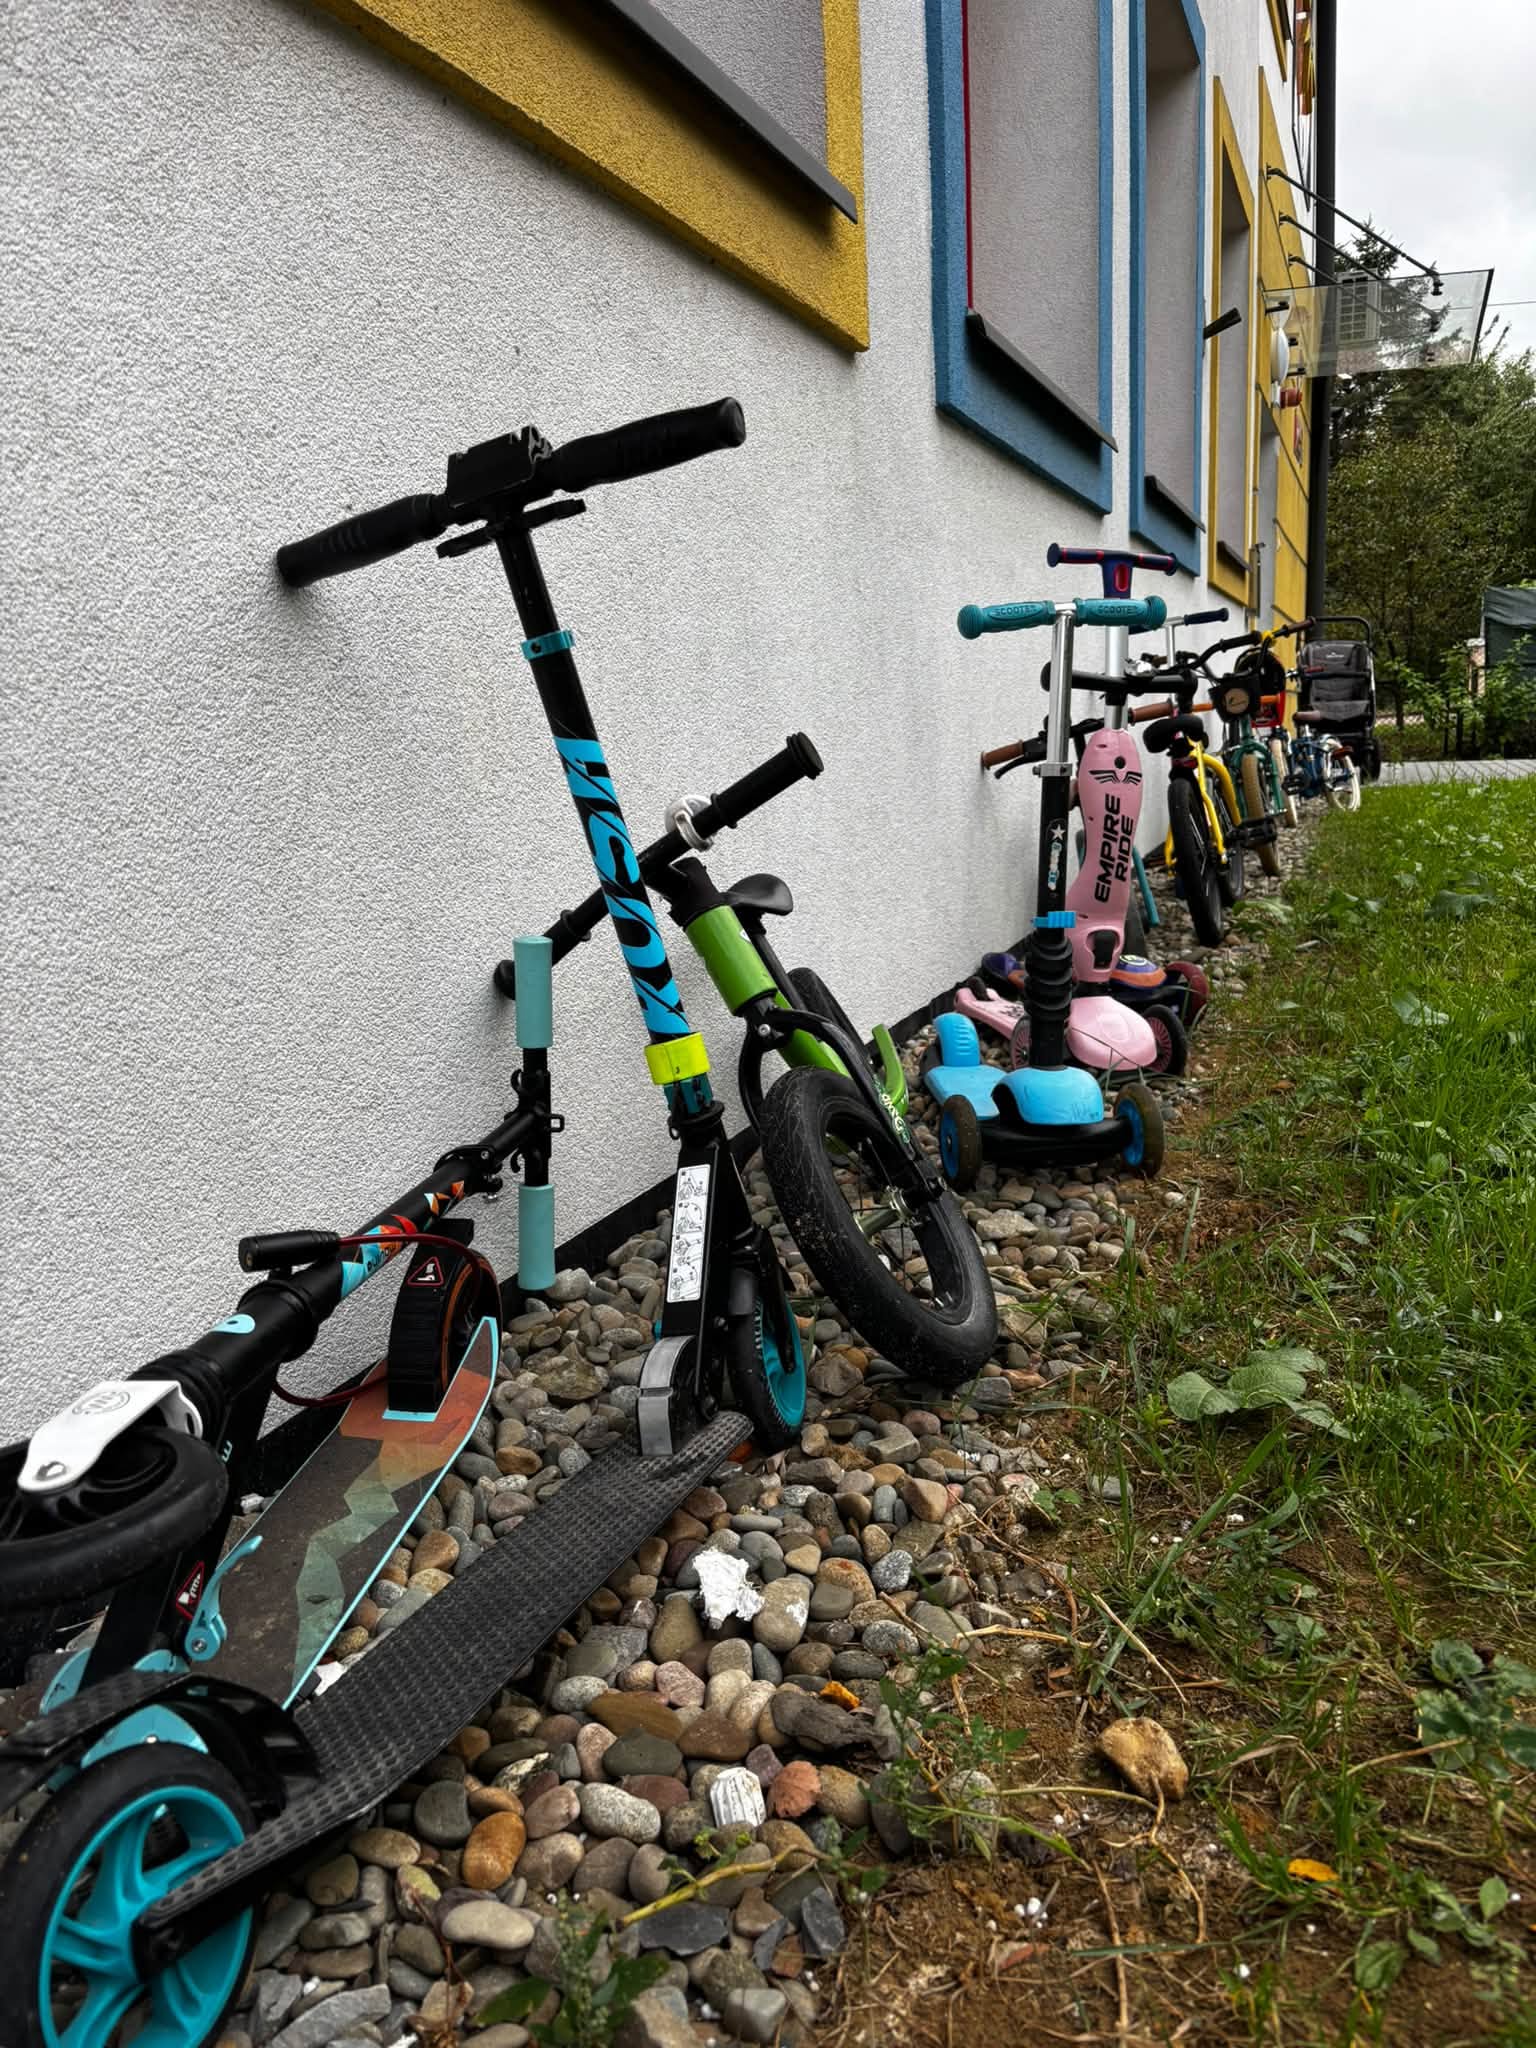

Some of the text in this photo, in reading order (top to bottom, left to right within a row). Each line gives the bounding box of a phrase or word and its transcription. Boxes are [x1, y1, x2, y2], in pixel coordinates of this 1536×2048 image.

[993, 603, 1038, 617] SCOOTER
[1098, 604, 1139, 616] SCOOTER
[1094, 793, 1121, 903] EMPIRE
[1114, 814, 1134, 882] RIDE
